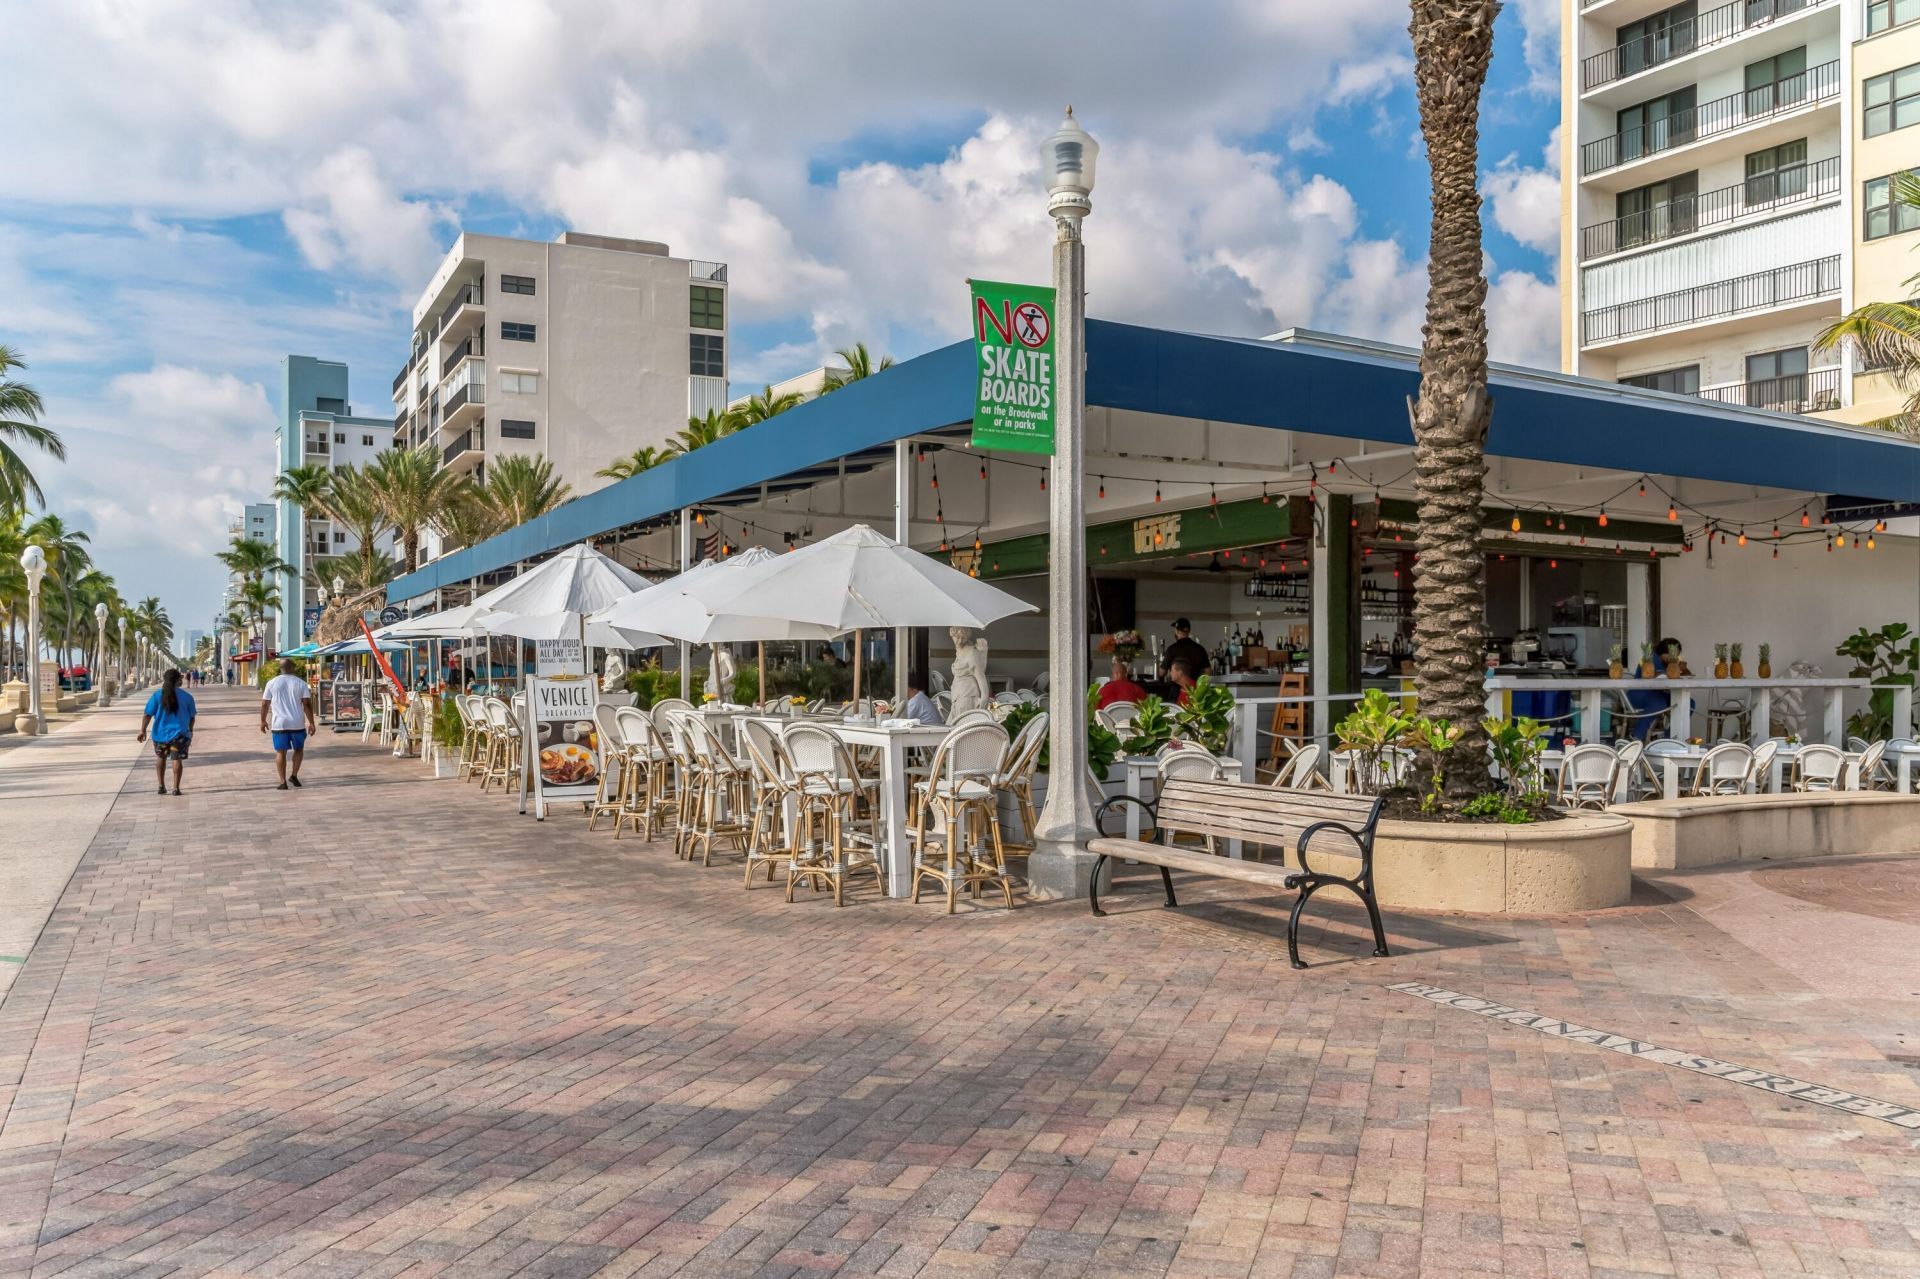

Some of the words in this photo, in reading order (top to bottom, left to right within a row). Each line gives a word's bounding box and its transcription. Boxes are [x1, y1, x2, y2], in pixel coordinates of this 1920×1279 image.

[981, 345, 1050, 384] SKATE
[980, 377, 1050, 409] BOARDS
[981, 406, 991, 414] on
[994, 405, 1006, 416] the
[1008, 406, 1049, 421] Broadwalk
[994, 418, 1003, 426] or
[1004, 416, 1012, 427] in
[1014, 420, 1036, 430] parks
[539, 639, 560, 649] HAPPY
[562, 639, 580, 649] HOUR
[540, 649, 551, 658] ALL
[552, 649, 563, 658] DAY
[541, 687, 588, 707] VENICE
[545, 708, 586, 717] BREAKFAST
[1398, 984, 1666, 1055] BUCHANAN
[1675, 1057, 1915, 1121] STREET
